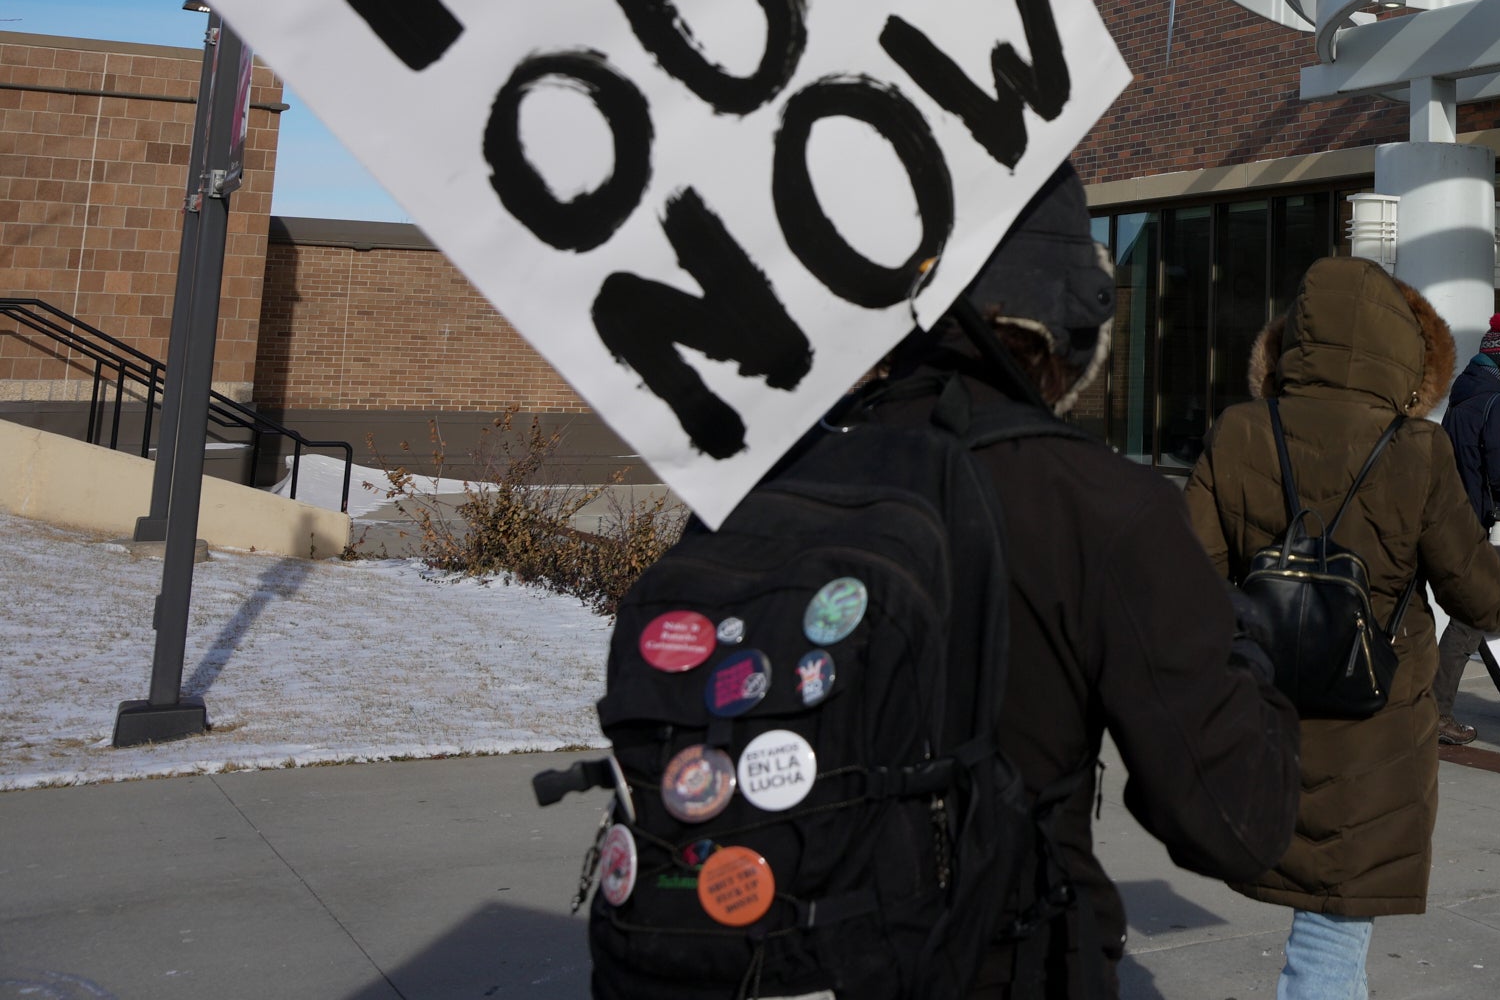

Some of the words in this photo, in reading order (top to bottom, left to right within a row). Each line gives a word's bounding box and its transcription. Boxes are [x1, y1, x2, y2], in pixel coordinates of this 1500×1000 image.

[746, 742, 800, 761] ESTAMOS
[748, 759, 770, 777] EN
[776, 755, 801, 771] LA
[749, 771, 806, 793] LUCHA
